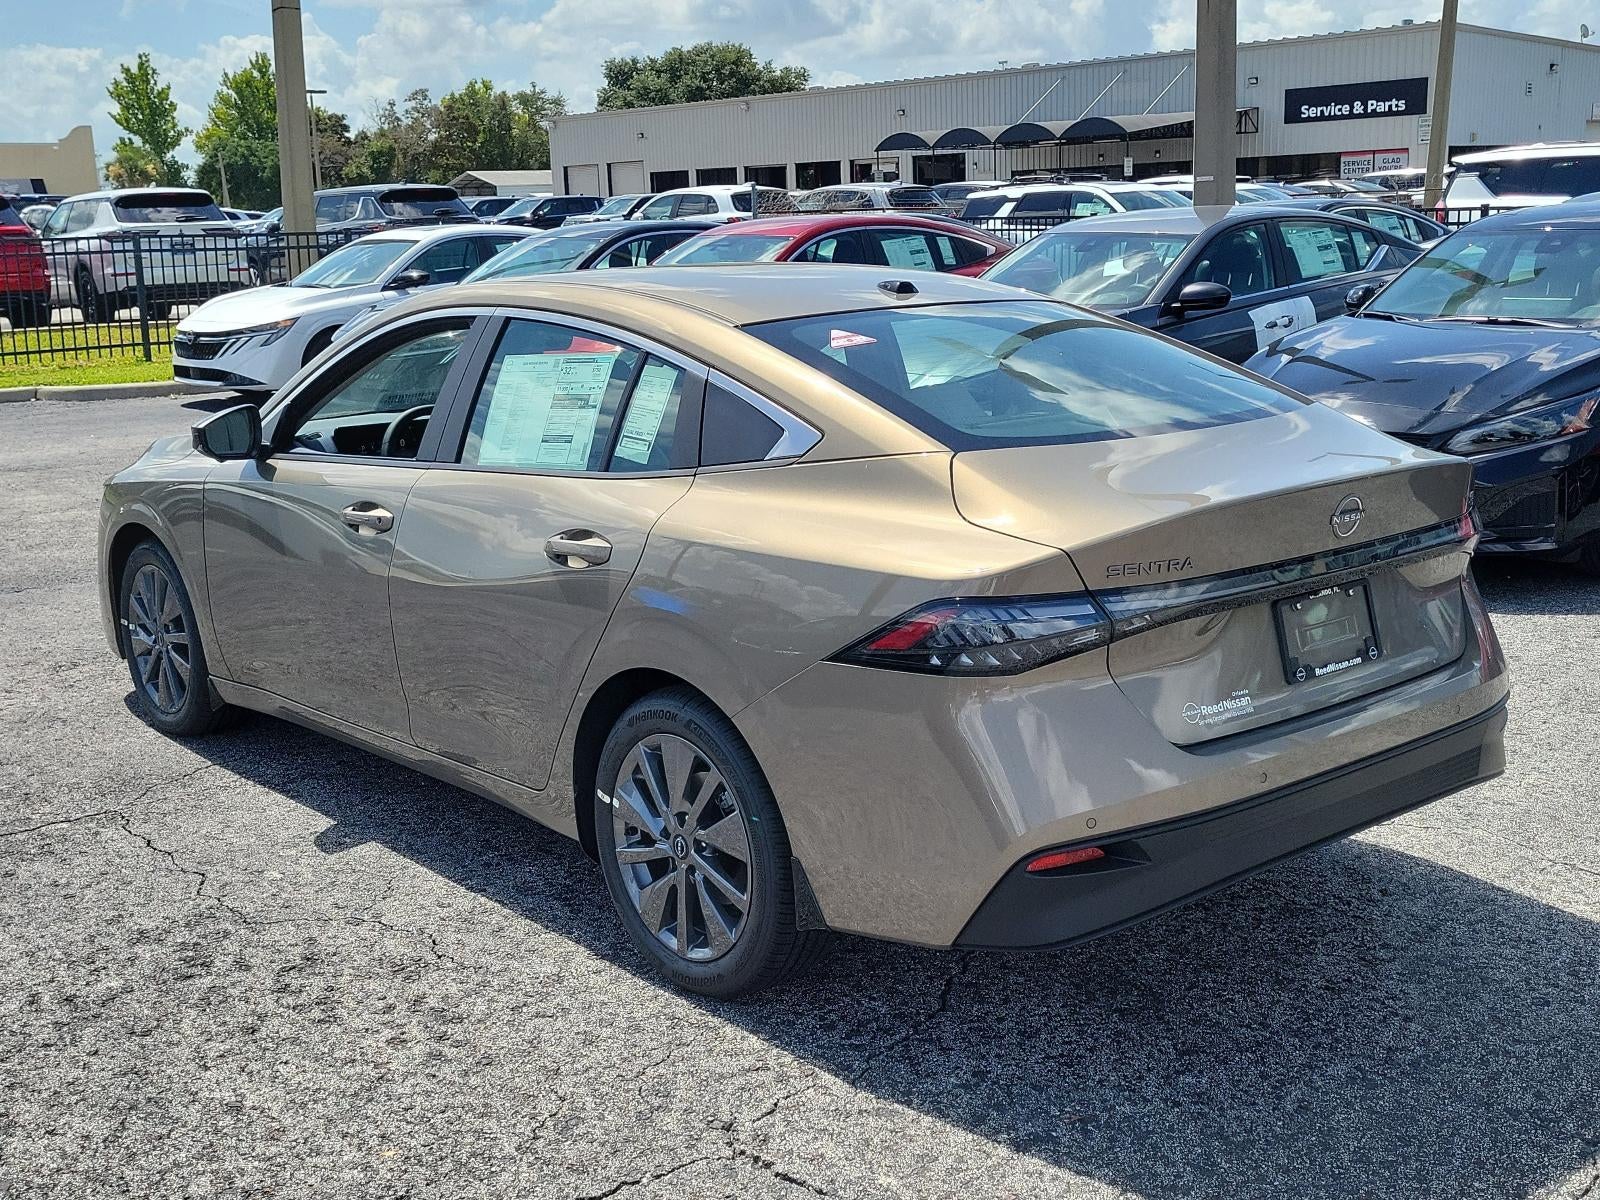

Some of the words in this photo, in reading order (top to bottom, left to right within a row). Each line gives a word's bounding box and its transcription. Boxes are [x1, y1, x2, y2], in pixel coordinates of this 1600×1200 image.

[1301, 102, 1350, 118] Service
[1353, 101, 1364, 114] &
[1367, 98, 1406, 113] Parts
[1343, 167, 1370, 175] CENTER
[1333, 511, 1365, 523] NISSAN
[1106, 556, 1194, 579] SENTRA
[1315, 656, 1362, 677] ReedNissan.com
[1200, 696, 1252, 715] ReedNissan
